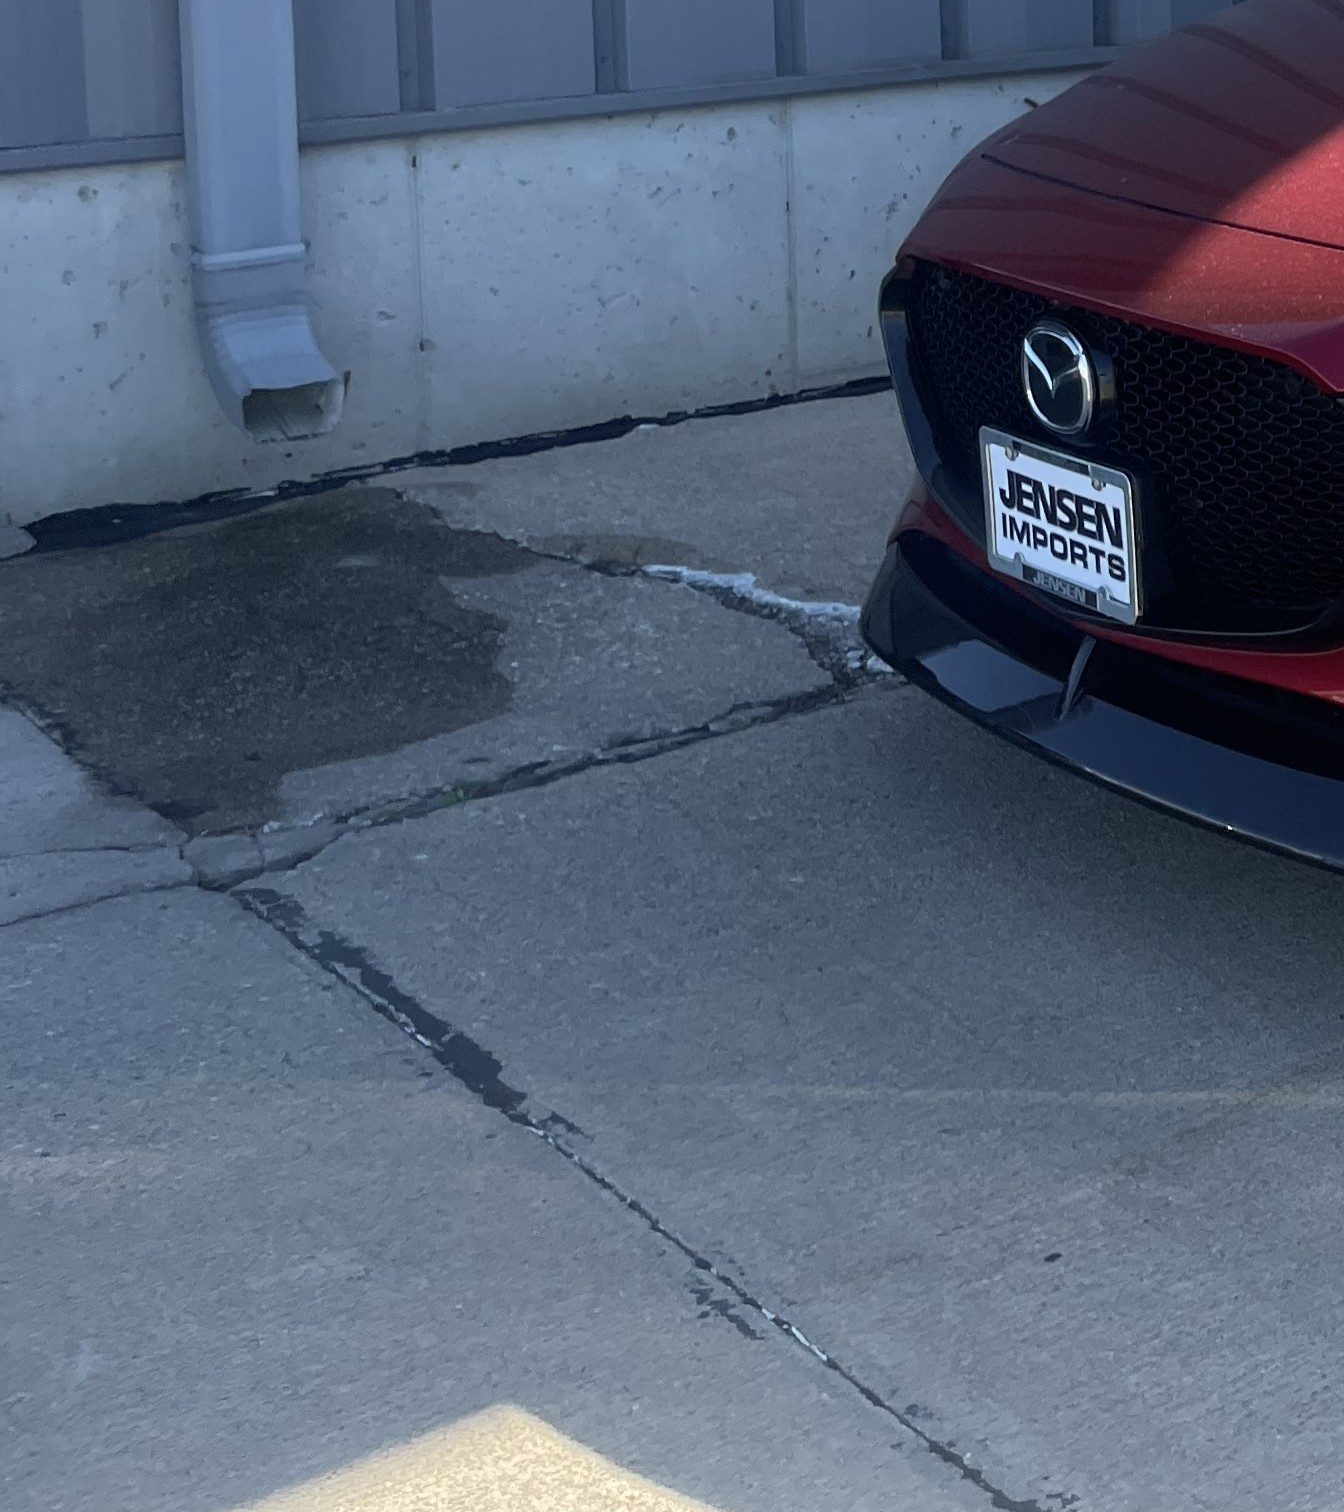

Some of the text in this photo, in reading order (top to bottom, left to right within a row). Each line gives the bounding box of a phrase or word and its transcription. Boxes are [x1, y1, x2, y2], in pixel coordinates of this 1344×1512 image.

[998, 468, 1124, 550] JENSEN
[1001, 511, 1127, 583] IMPORTS
[1033, 570, 1087, 603] JENSEN
